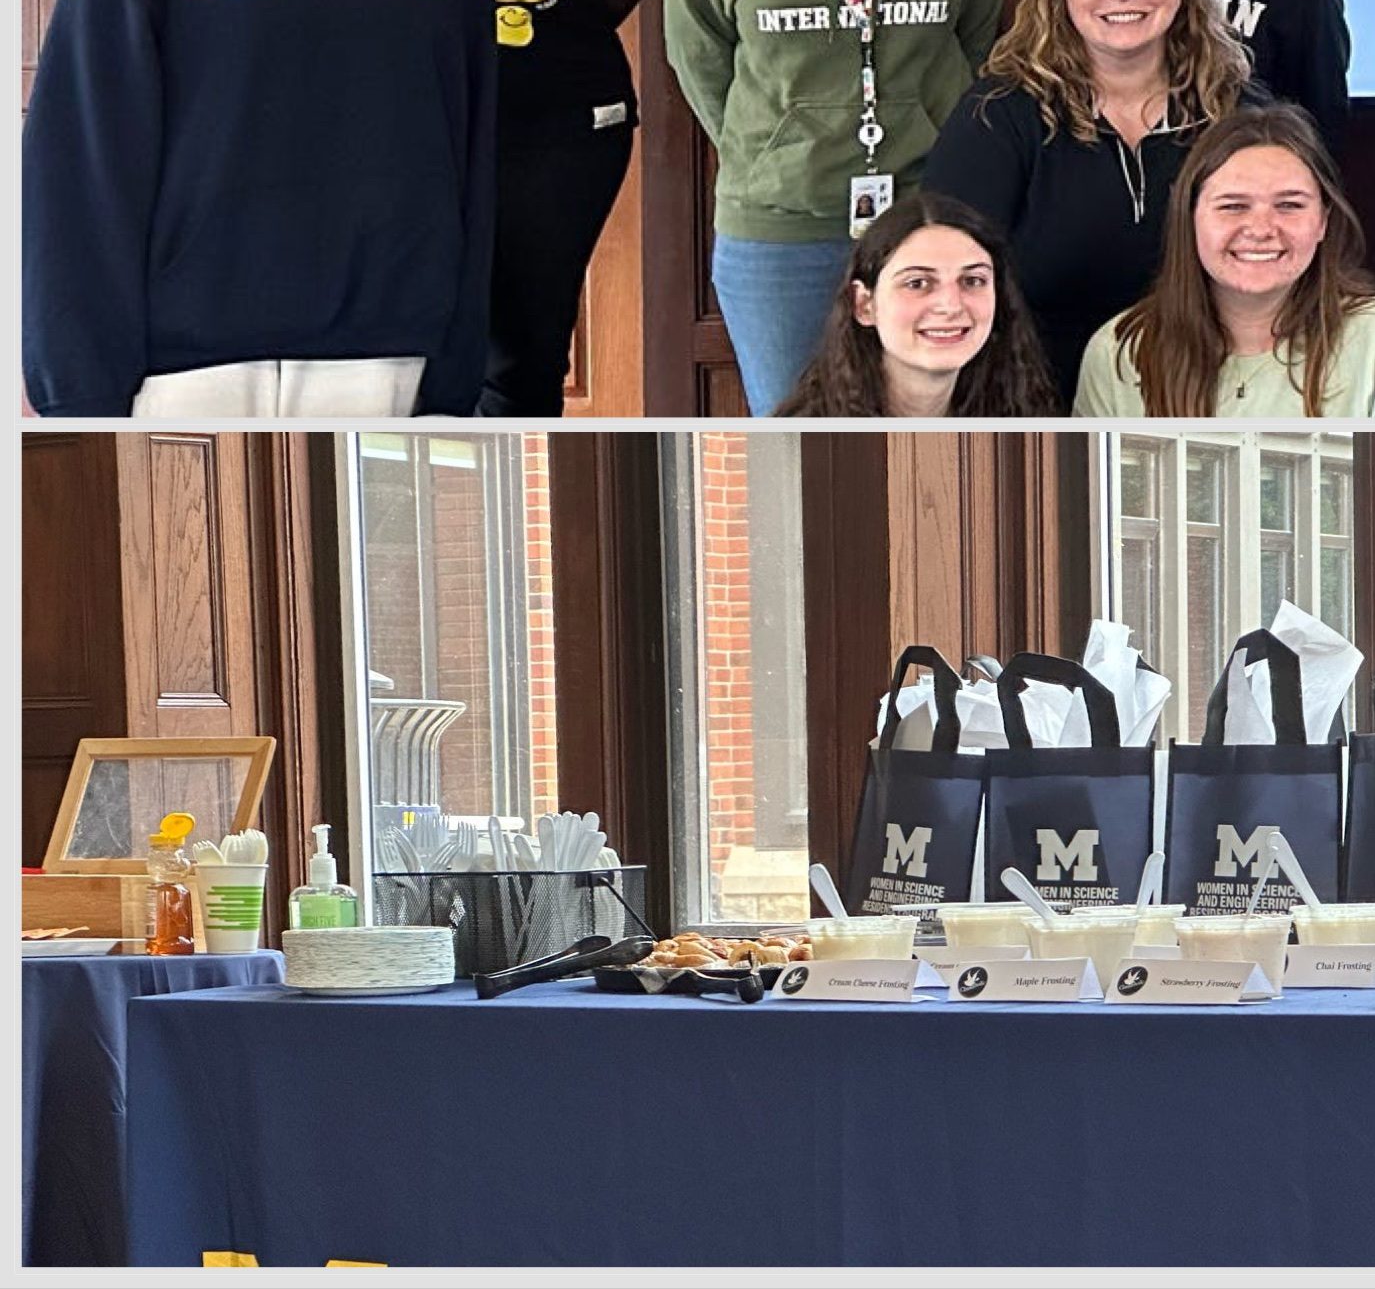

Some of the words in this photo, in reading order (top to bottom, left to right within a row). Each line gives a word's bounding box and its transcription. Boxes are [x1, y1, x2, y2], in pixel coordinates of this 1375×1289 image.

[882, 823, 933, 878] M
[1036, 829, 1099, 881] M
[1214, 824, 1280, 878] M
[870, 877, 894, 891] WOMEN
[896, 880, 903, 891] IN
[904, 881, 945, 898] SCIENCE
[1059, 886, 1072, 899] IN
[1073, 887, 1119, 900] SCIENCE
[1197, 882, 1234, 896] WOMEN
[1237, 883, 1249, 896] IN
[868, 889, 883, 902] AND
[883, 891, 940, 904] ENGINEERING
[1197, 895, 1218, 907] AND
[1219, 896, 1298, 909] ENGINEERING
[1315, 961, 1335, 971] Chai
[1336, 962, 1372, 971] Frosting
[1014, 977, 1039, 987] Maple
[1041, 976, 1076, 987] Frosting
[1160, 978, 1204, 989] Strawberry
[1205, 978, 1242, 989] Frosting
